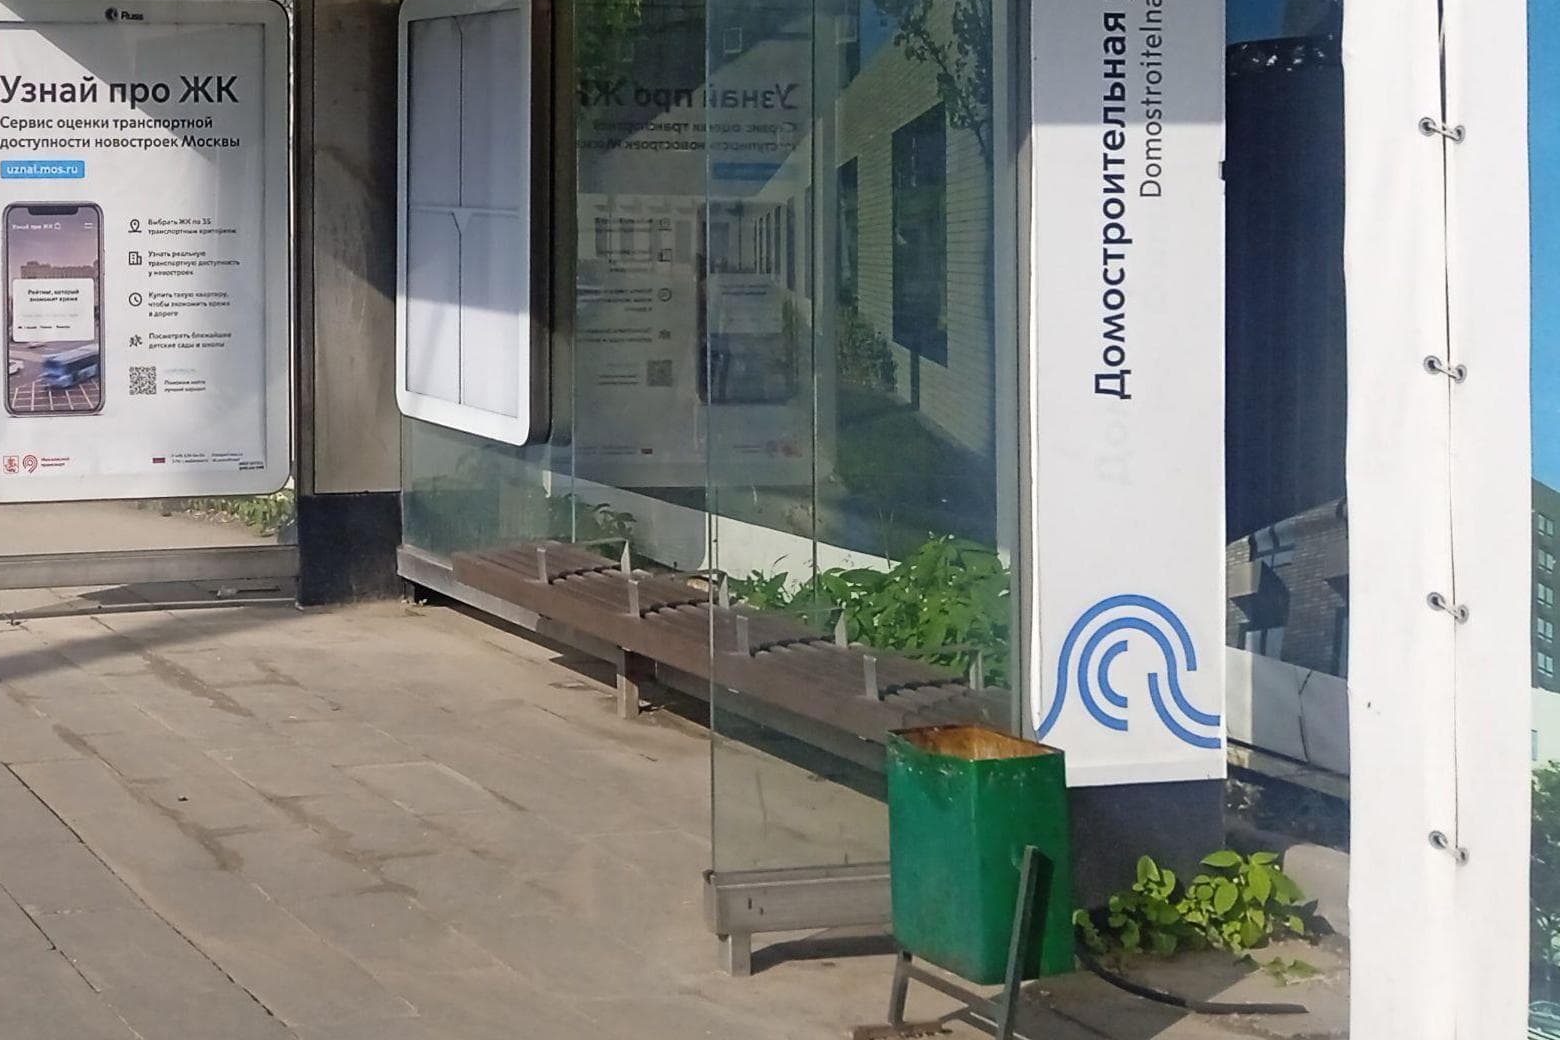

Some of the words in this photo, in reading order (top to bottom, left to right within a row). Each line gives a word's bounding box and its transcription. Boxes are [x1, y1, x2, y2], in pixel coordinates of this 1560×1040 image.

[120, 11, 144, 21] Russ
[0, 74, 98, 103] Узнай
[109, 81, 171, 110] про
[178, 74, 240, 104] ЖК
[0, 116, 53, 131] Сервис
[56, 118, 110, 130] оценки
[112, 116, 214, 132] транспортной
[0, 136, 91, 150] доступности
[94, 136, 179, 150] новостроек
[180, 135, 240, 147] Москвы
[6, 165, 79, 175] uznai.mos.ru
[1093, 12, 1133, 400] Домостроительная
